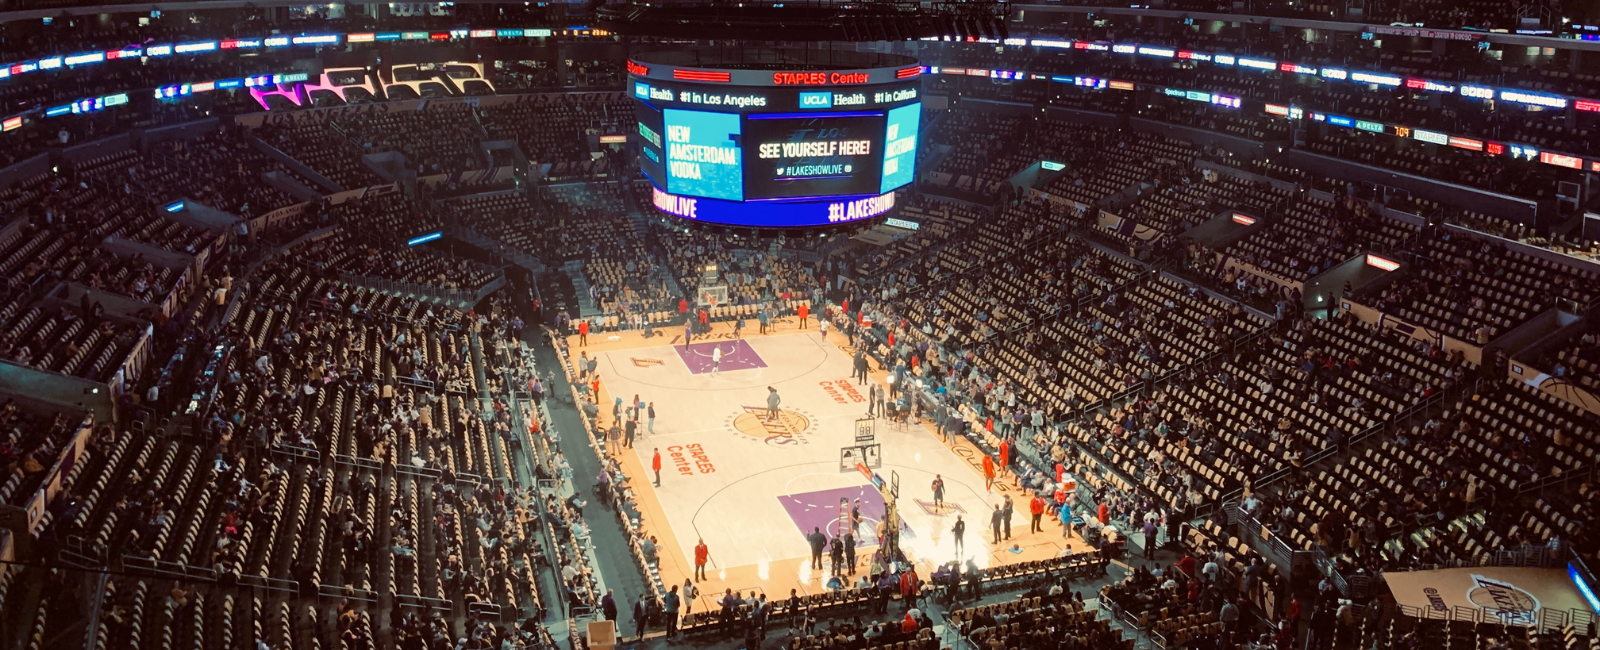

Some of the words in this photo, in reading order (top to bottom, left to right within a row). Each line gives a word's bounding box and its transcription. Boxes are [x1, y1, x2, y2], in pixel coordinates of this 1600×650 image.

[773, 72, 827, 85] STAPLES
[830, 72, 869, 84] Center
[650, 88, 674, 101] Health
[680, 92, 691, 103] #1
[692, 92, 702, 104] in
[703, 93, 721, 105] Los
[723, 94, 766, 108] Angeles
[803, 96, 828, 105] UCLA
[833, 94, 866, 106] Health
[874, 93, 884, 103] #1
[885, 92, 892, 102] in
[893, 88, 917, 101] California
[668, 125, 690, 143] NEW
[1362, 123, 1382, 131] DELTA
[1415, 131, 1446, 144] STAPLES
[759, 143, 780, 158] SEE
[782, 141, 837, 157] YOURSELF
[839, 140, 870, 155] HERE!
[670, 161, 701, 180] VODKA
[786, 164, 842, 176] #LAKESHOWLIVE
[819, 381, 848, 404] Center
[835, 379, 867, 403] STAPLES
[667, 445, 694, 476] Center
[686, 443, 716, 474] STAPLES
